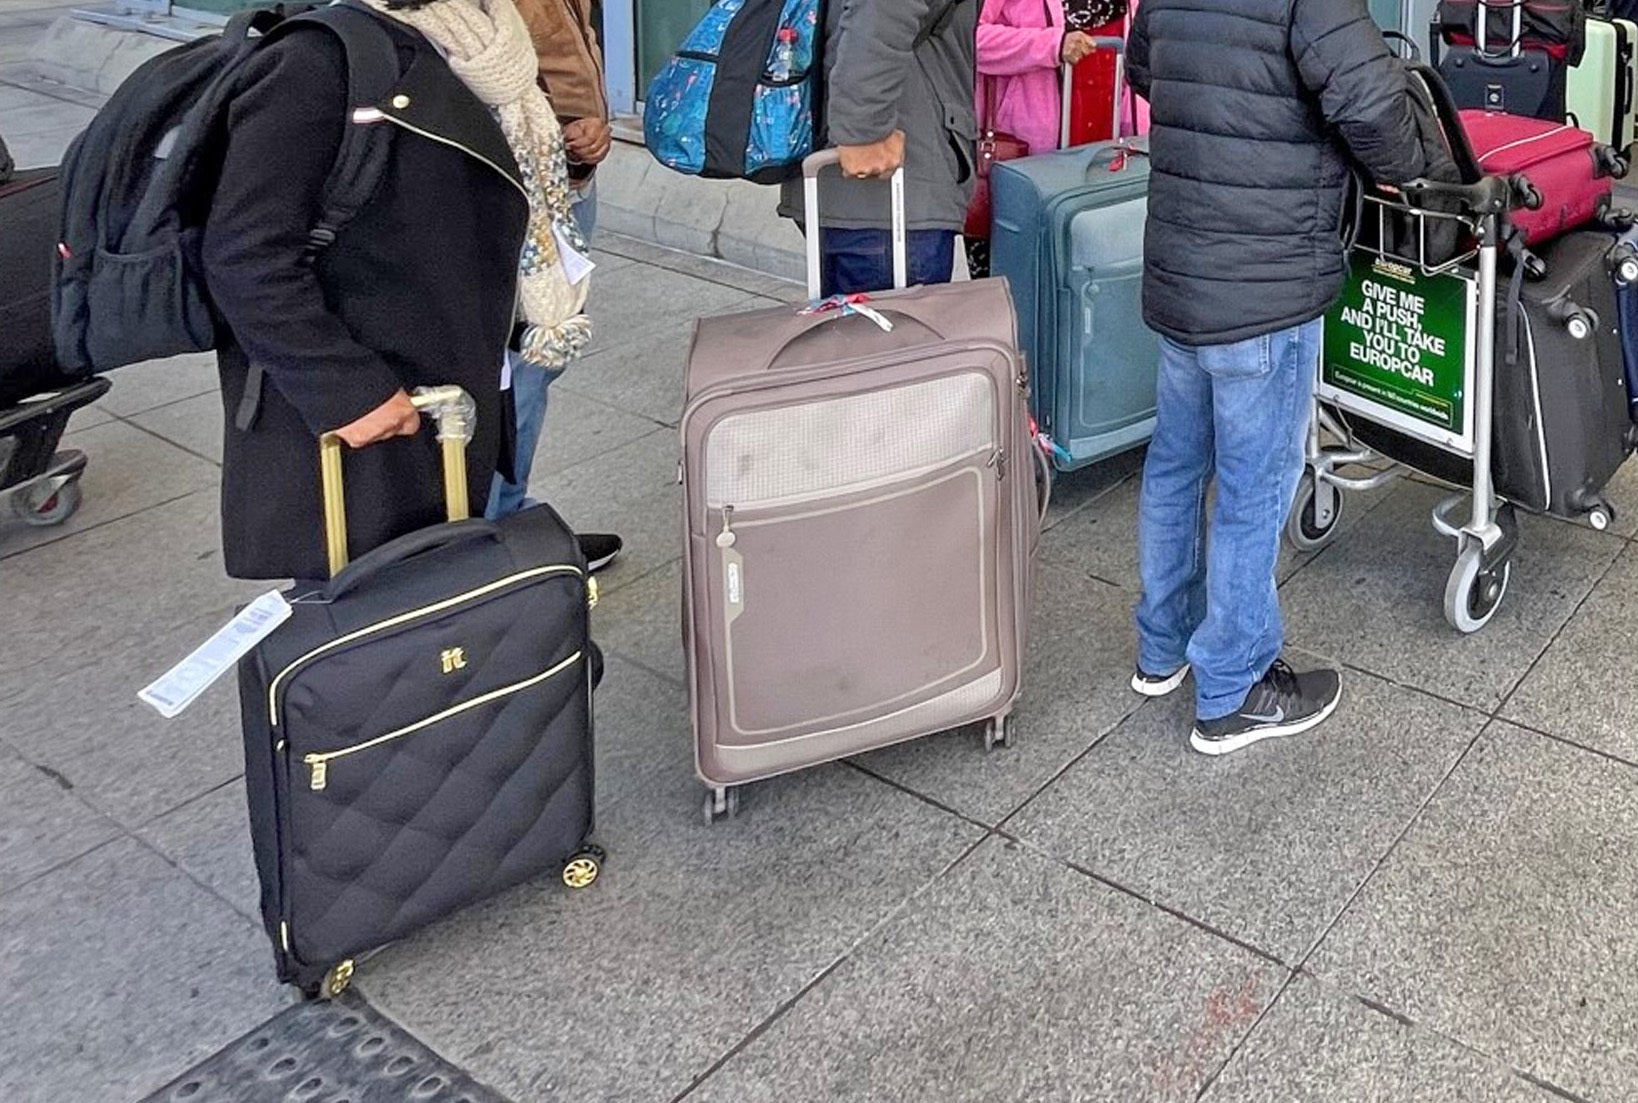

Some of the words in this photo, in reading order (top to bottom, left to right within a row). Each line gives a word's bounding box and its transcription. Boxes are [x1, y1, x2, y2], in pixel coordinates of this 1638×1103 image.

[1361, 279, 1397, 305] GIVE
[1400, 291, 1424, 315] ME
[1341, 306, 1372, 329] AND
[1376, 317, 1401, 341] I'LL
[1404, 327, 1445, 357] TAKE
[1363, 298, 1373, 315] A
[1376, 302, 1423, 331] PUSH,
[1350, 342, 1434, 387] EUROPCAR
[1363, 331, 1395, 355] YOU
[1398, 342, 1420, 364] TO
[440, 647, 467, 673] it
